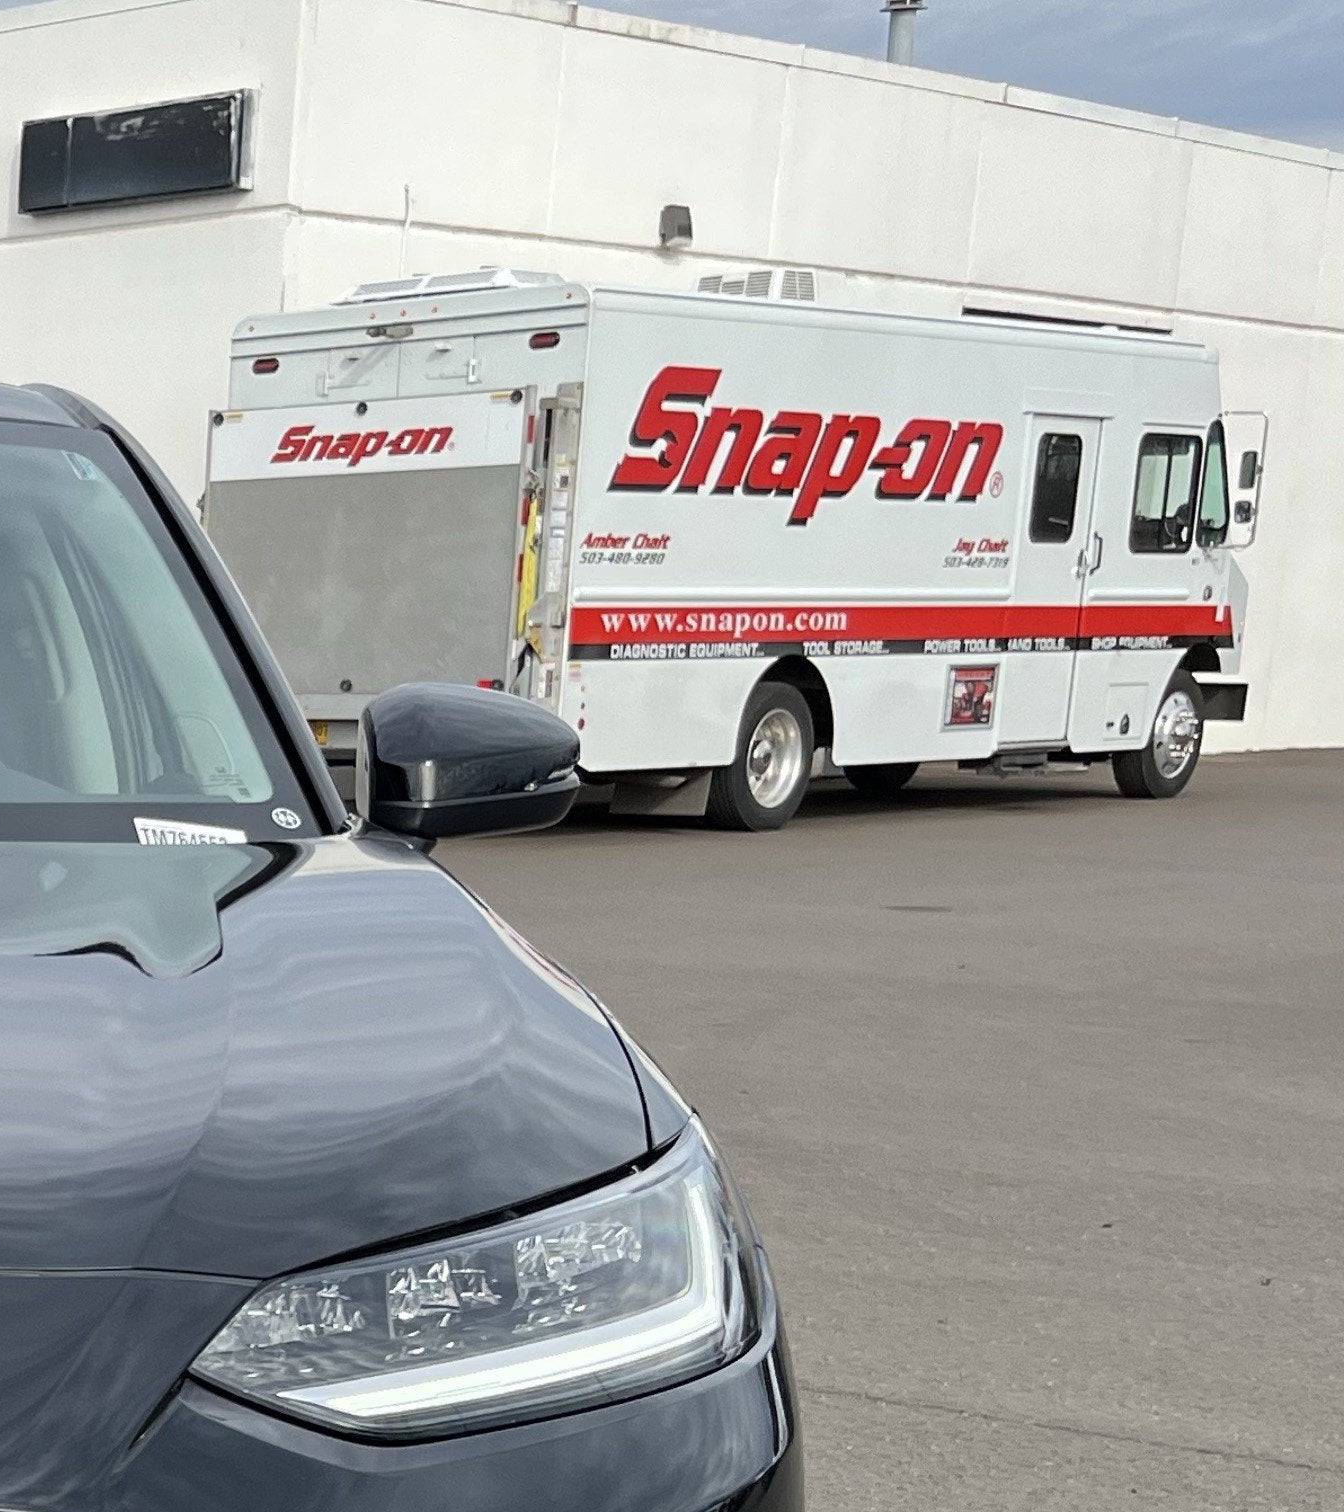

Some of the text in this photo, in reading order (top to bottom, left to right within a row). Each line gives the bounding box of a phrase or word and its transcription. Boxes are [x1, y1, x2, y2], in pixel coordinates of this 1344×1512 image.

[270, 425, 454, 467] Snap-on
[605, 365, 1004, 527] Snap-on
[580, 532, 631, 549] Amber
[600, 611, 848, 639] www.snapon.com
[610, 642, 687, 659] DIAGNOSTIC
[803, 640, 831, 656] TOOL
[924, 638, 962, 653] POWER
